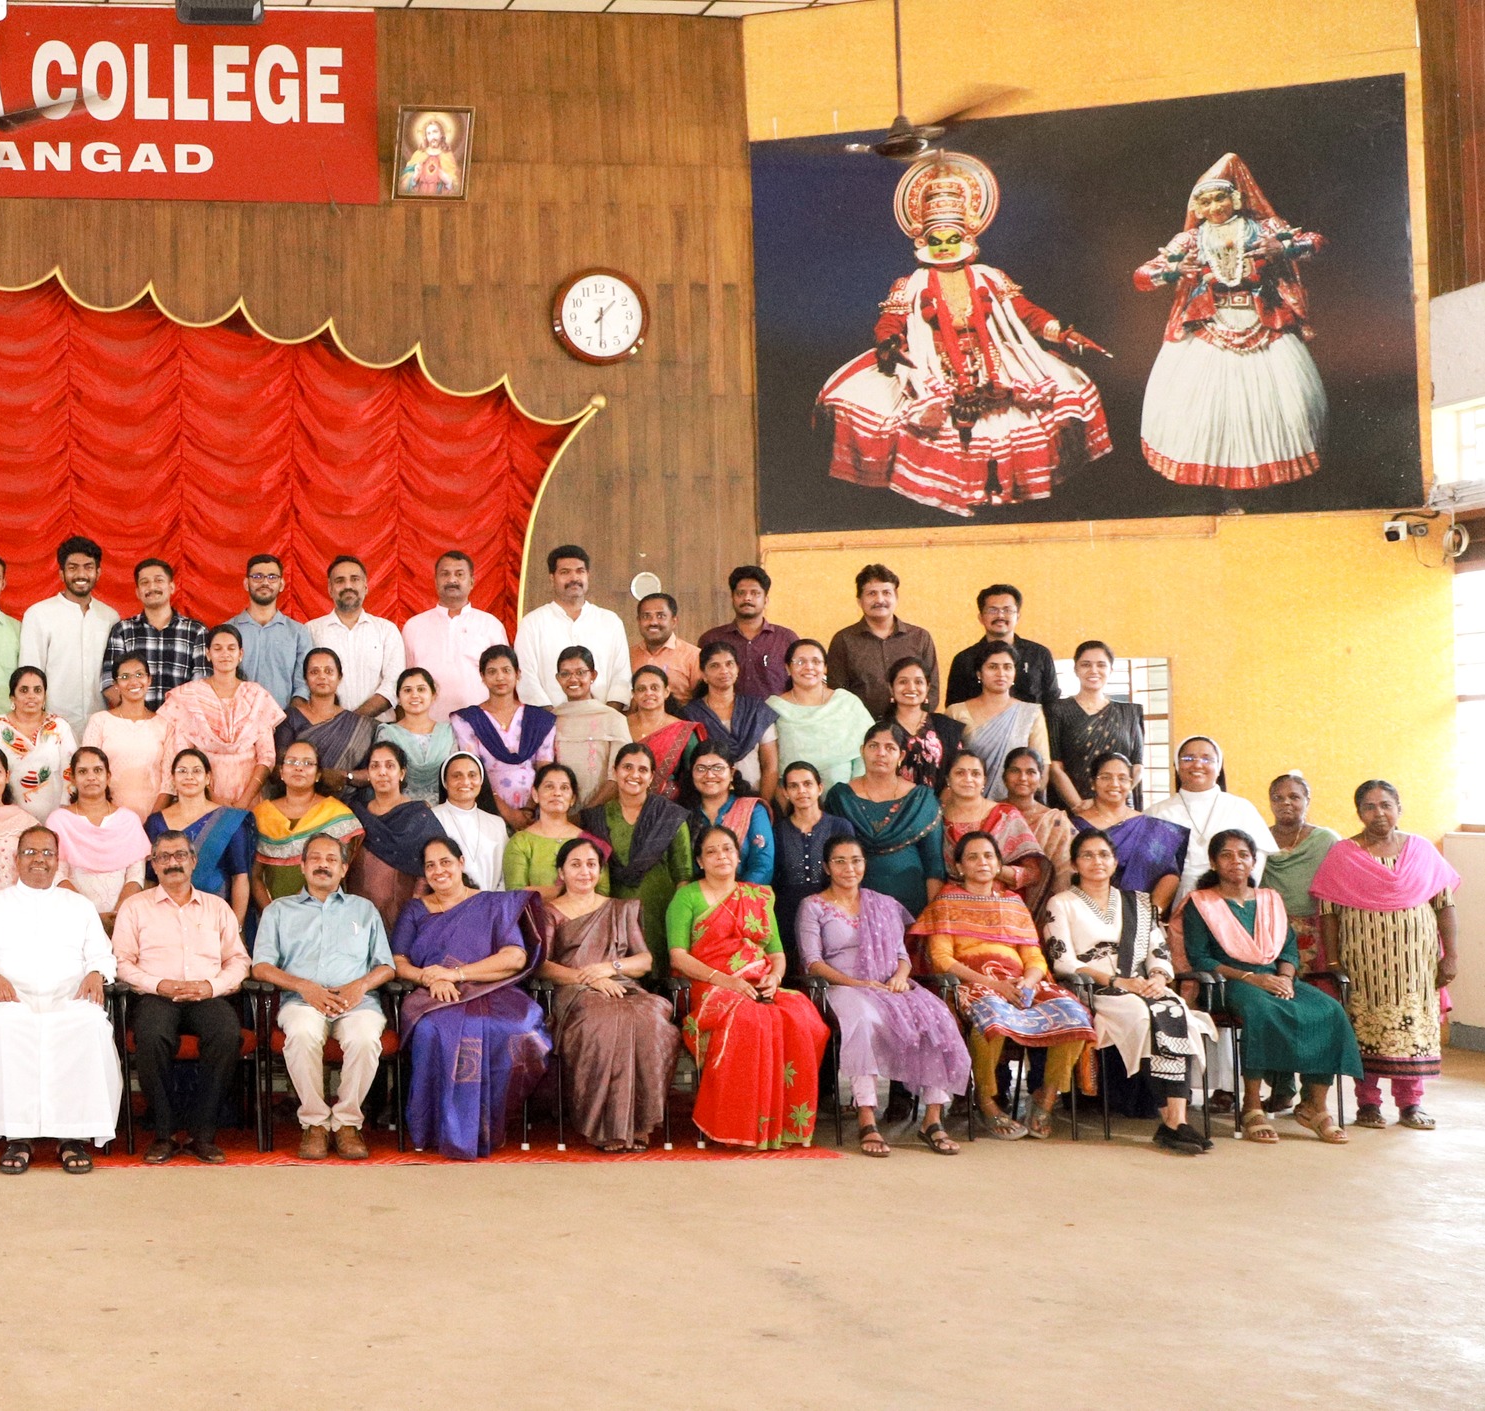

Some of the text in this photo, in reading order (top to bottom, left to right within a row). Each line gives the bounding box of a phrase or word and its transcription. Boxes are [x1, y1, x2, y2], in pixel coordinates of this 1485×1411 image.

[31, 41, 345, 125] COLLEGE
[582, 287, 590, 297] 11
[594, 283, 605, 293] 12
[612, 286, 616, 296] 1
[572, 298, 582, 308] 10
[621, 297, 628, 306] 2
[570, 312, 577, 322] 9
[626, 311, 633, 320] 3
[575, 326, 582, 336] 8
[623, 325, 629, 335] 4
[586, 337, 592, 346] 7
[613, 336, 621, 345] 5
